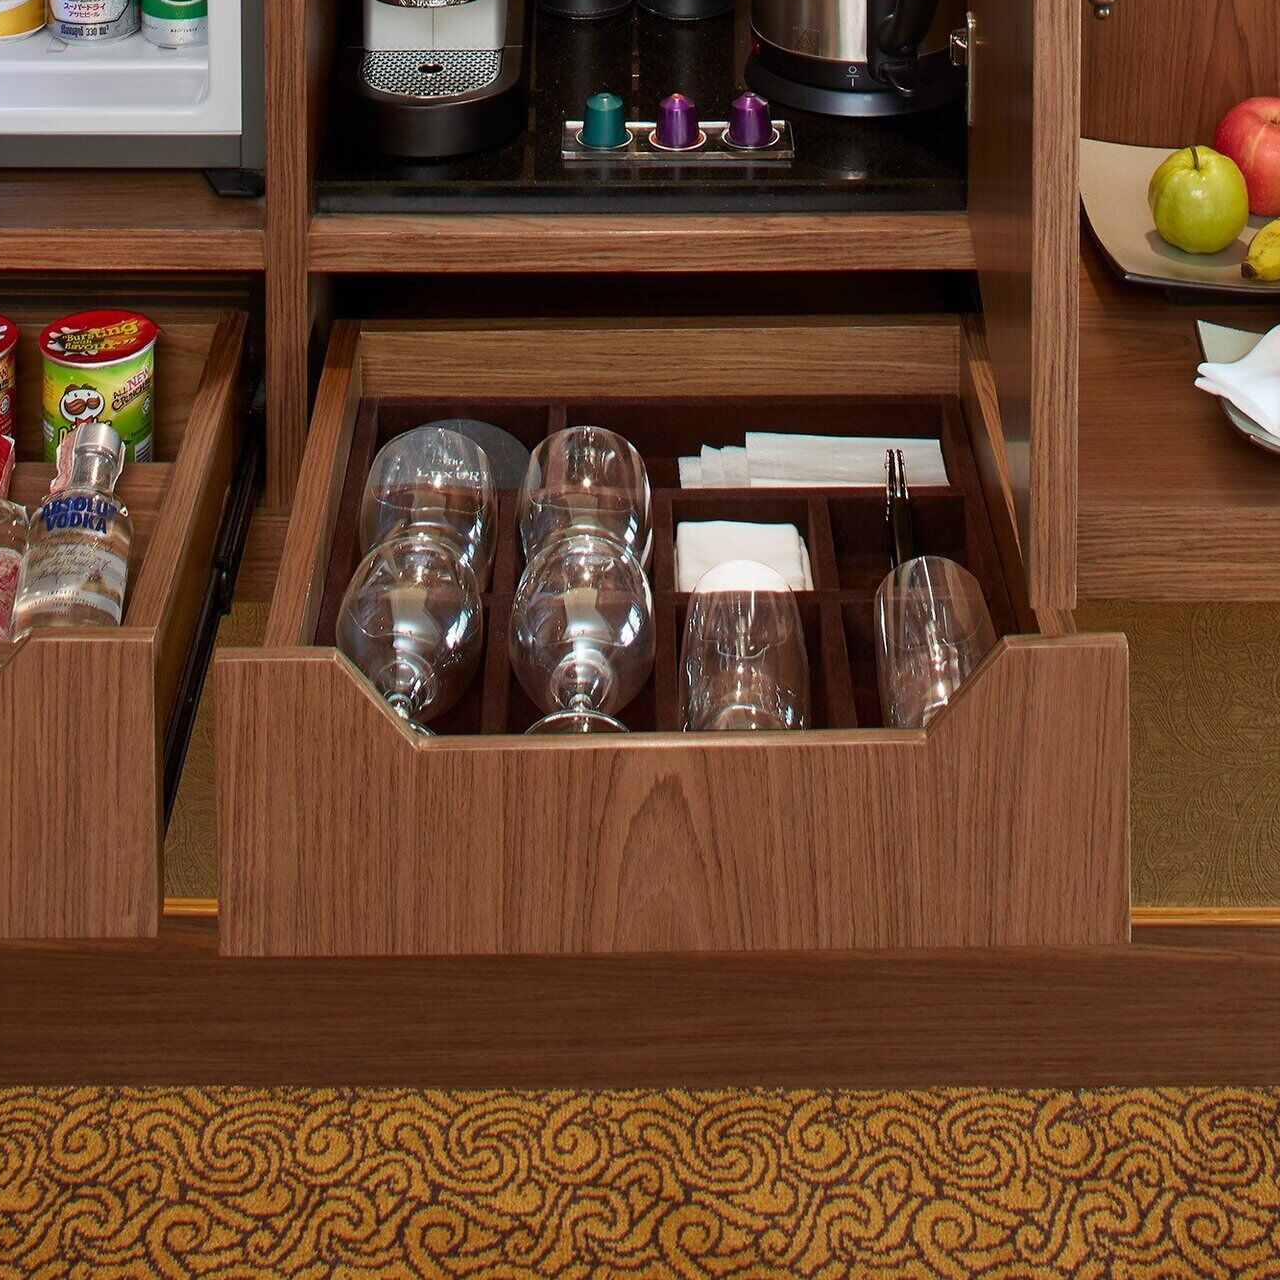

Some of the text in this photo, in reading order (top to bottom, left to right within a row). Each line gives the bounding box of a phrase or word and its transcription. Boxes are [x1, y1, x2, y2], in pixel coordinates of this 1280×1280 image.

[64, 2, 106, 11] スーパードライ
[113, 368, 150, 400] ALL NEW
[41, 496, 118, 524] ABSOLUT
[46, 511, 108, 535] VODKA
